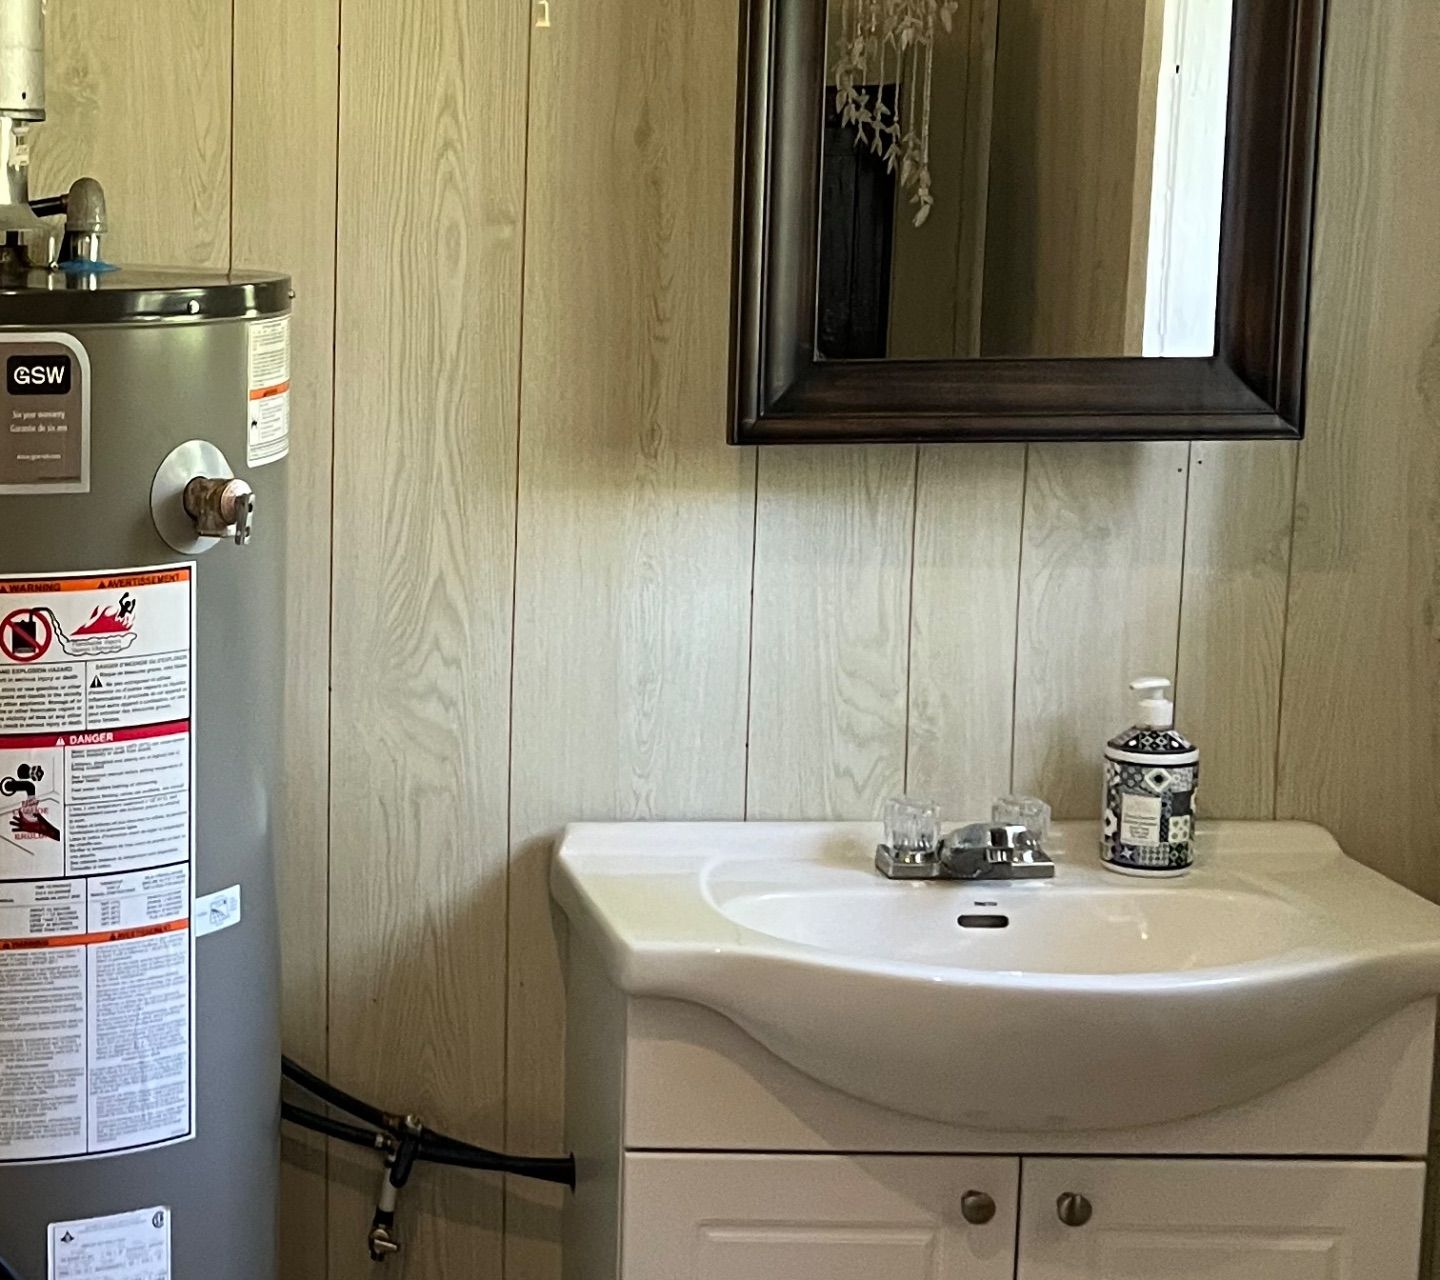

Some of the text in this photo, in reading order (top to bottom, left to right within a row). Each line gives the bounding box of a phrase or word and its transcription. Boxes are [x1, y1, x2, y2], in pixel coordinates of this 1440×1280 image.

[13, 366, 65, 385] GSW
[9, 583, 61, 592] WARNING
[106, 574, 180, 589] AVERTISSEMENT
[69, 733, 113, 745] DANGER
